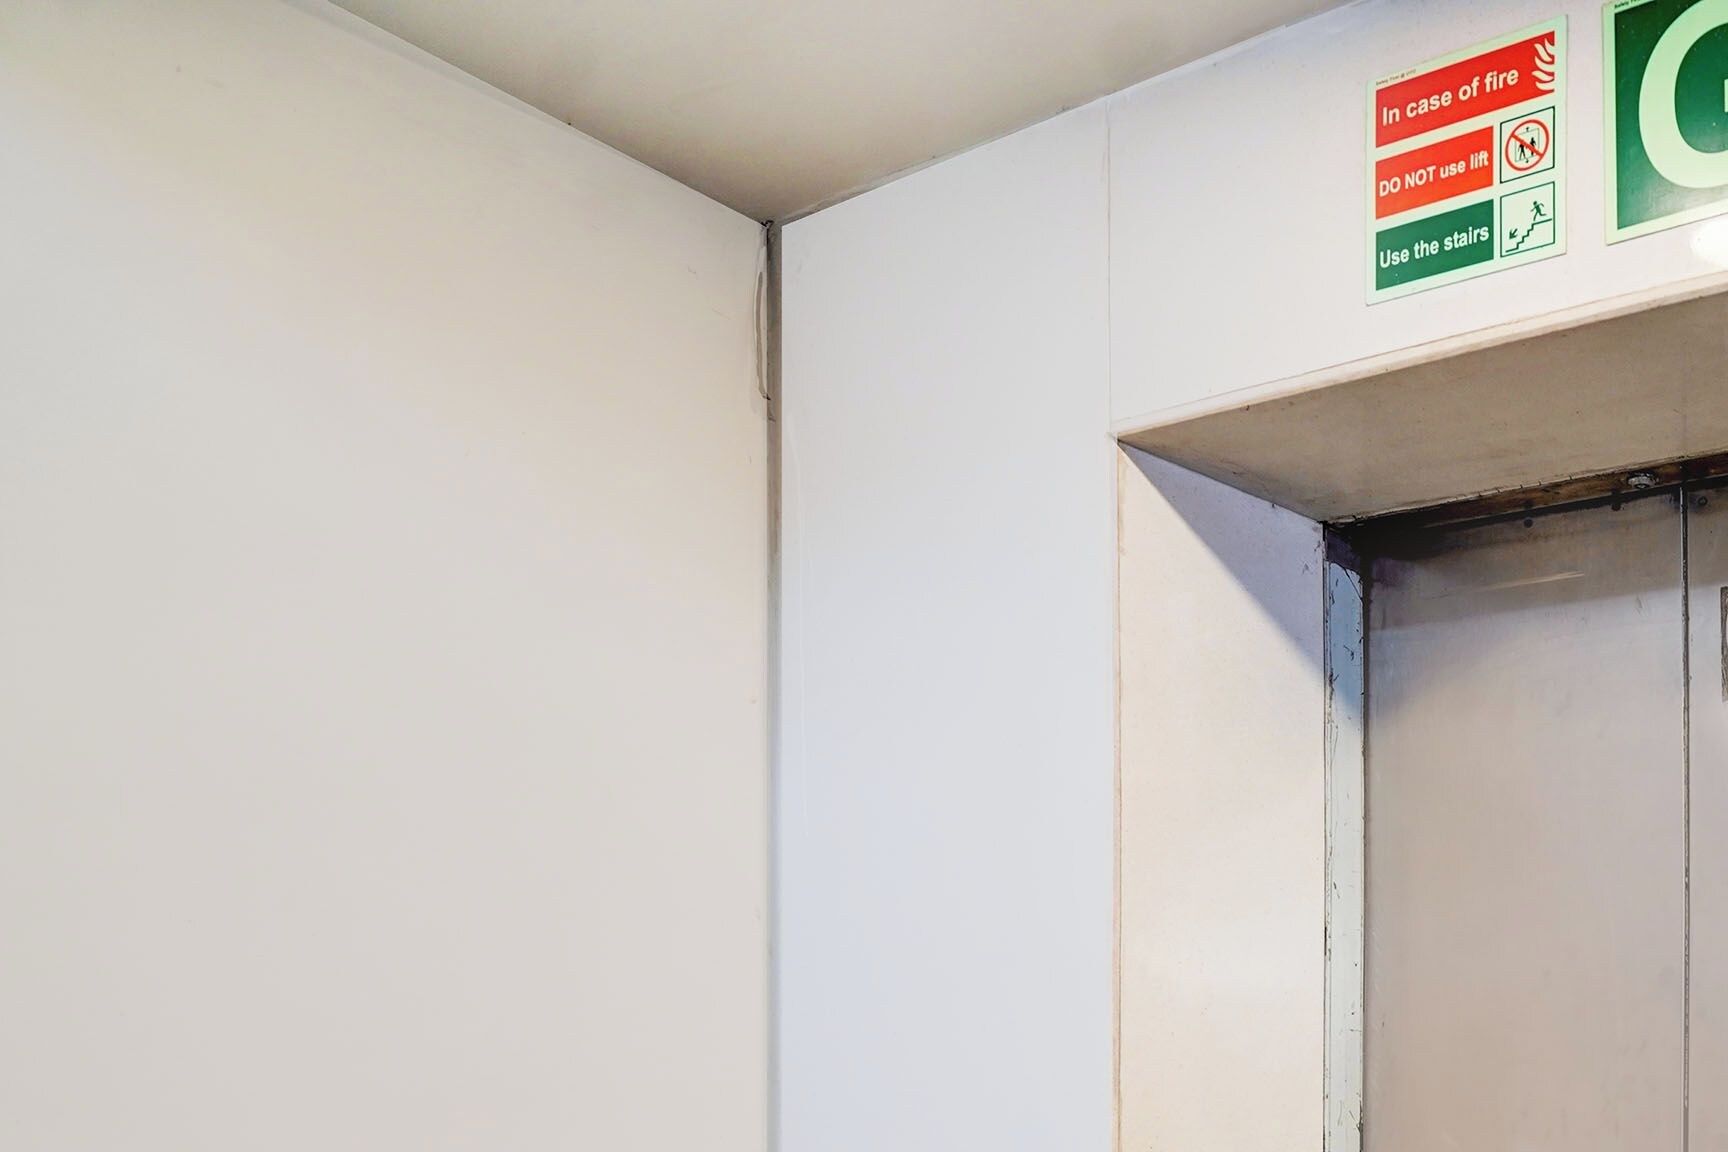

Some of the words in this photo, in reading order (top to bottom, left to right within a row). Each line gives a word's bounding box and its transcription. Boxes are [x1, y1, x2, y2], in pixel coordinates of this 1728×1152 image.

[1382, 106, 1400, 126] In
[1406, 91, 1453, 118] case
[1458, 76, 1480, 101] of
[1484, 69, 1519, 93] fire
[1379, 176, 1401, 197] DO
[1404, 165, 1436, 189] NOT
[1440, 160, 1466, 179] use
[1470, 150, 1489, 170] lift
[1380, 248, 1410, 268] Use
[1413, 239, 1440, 259] the
[1443, 226, 1490, 251] stairs
